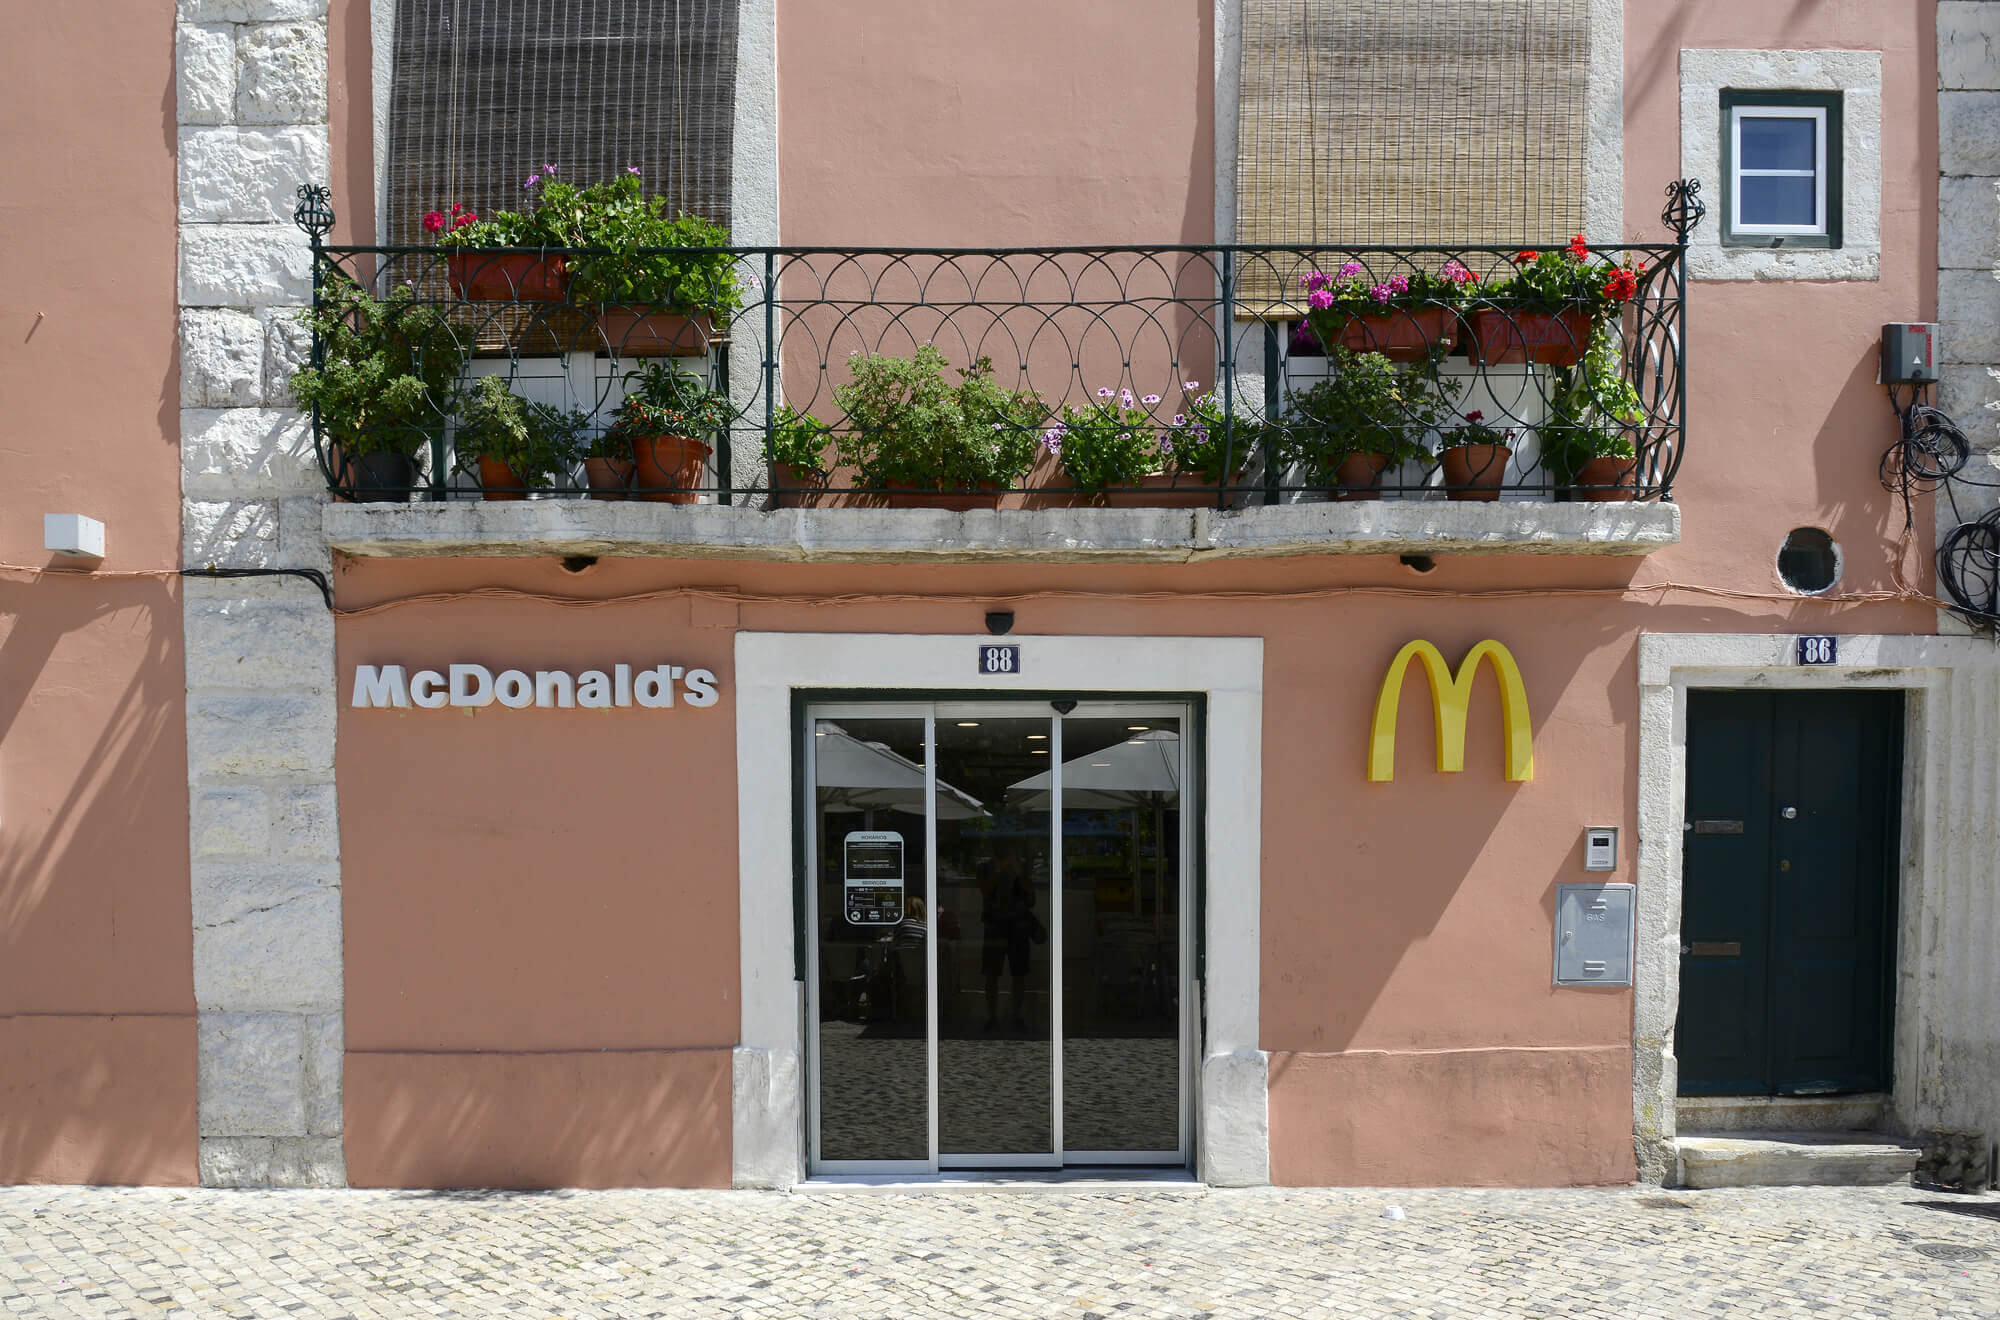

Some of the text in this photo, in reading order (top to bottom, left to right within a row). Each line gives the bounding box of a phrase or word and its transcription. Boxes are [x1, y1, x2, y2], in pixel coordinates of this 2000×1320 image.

[986, 648, 1012, 672] 88
[1805, 638, 1831, 663] 86
[352, 664, 719, 708] McDonald's
